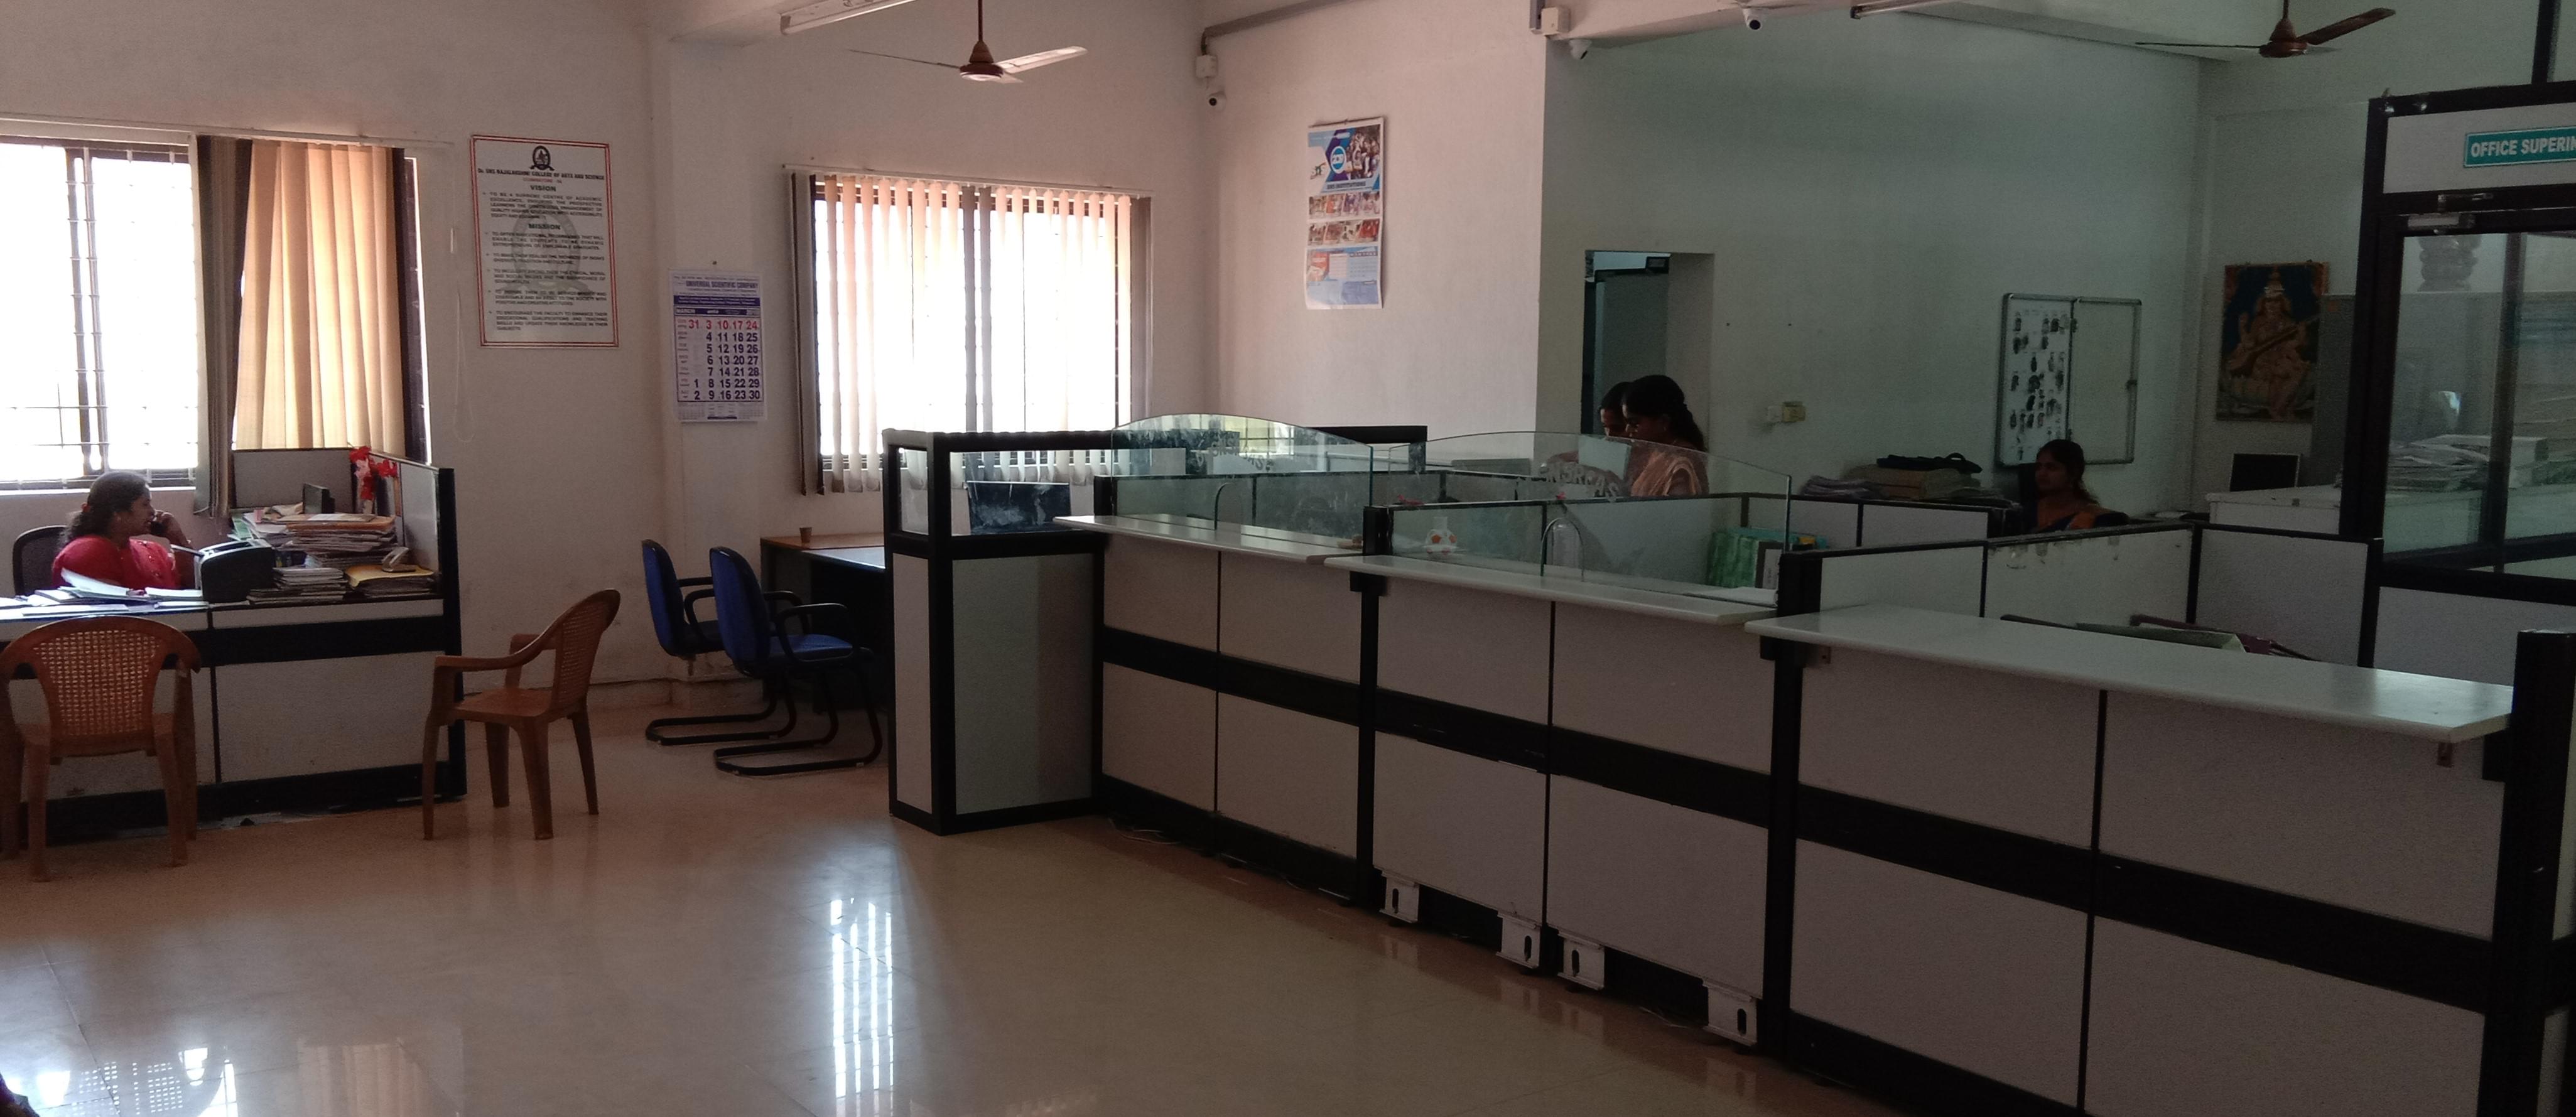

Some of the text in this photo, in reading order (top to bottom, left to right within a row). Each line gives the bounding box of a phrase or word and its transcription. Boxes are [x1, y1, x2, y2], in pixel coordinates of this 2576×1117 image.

[2470, 139, 2518, 157] OFFICE
[688, 320, 757, 330] 31 3 10 17 24
[706, 332, 757, 342] 4 11 18 25
[706, 344, 758, 353] 5 12 19 26
[707, 355, 758, 365] 6 13 20 27
[708, 367, 759, 376] 7 14 21 28
[694, 379, 760, 387] 1 8 15 22 29
[694, 391, 760, 400] 2 9 16 23 30
